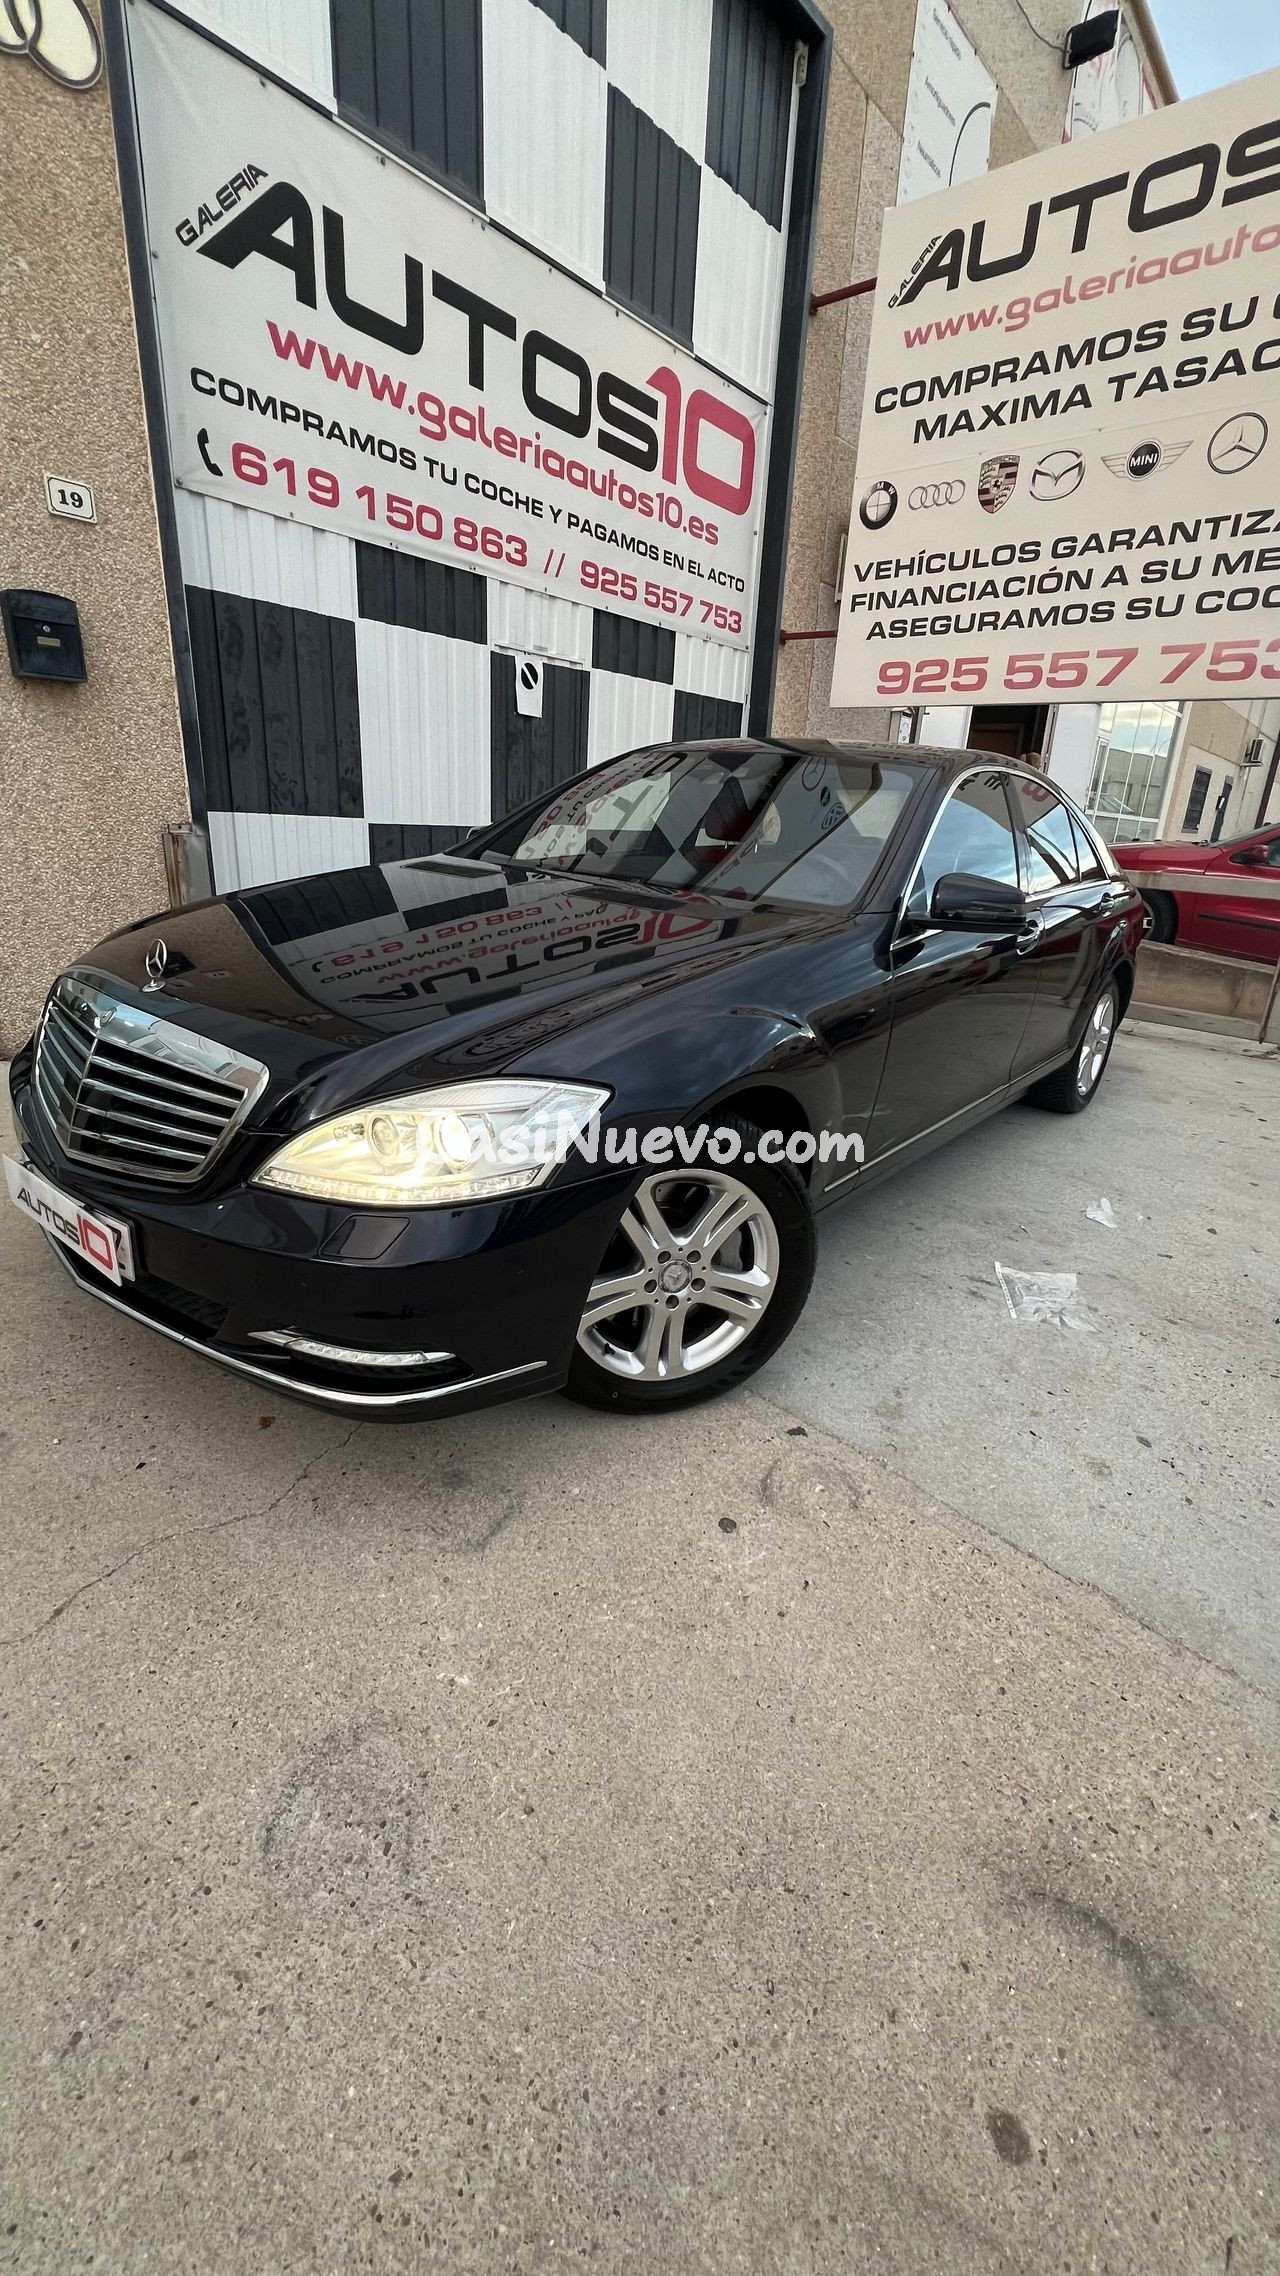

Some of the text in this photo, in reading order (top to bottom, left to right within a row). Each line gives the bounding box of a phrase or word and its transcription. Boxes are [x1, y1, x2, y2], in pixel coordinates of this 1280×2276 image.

[175, 163, 268, 247] GALERIA
[887, 234, 942, 309] GALERIA
[874, 295, 1259, 414] COMPRAMOS SU
[266, 319, 719, 545] www.galeriaautos10.es
[912, 383, 1093, 444] MAXIMA
[190, 367, 745, 593] COMPRAMOS TU COCHE Y PAGAMOS EN EL ACTO
[1129, 452, 1158, 468] MINI
[58, 489, 84, 509] 19
[231, 442, 340, 509] 619
[355, 485, 443, 541] 150
[453, 516, 528, 568] 863
[580, 559, 638, 602] 925
[643, 581, 693, 617] 557
[699, 600, 742, 634] 753
[853, 508, 1280, 583] VEHÍCULOS GARANTIZ
[850, 565, 1094, 613] FINANCIACIÓN
[1100, 564, 1130, 589] A
[1140, 555, 1202, 584] SU
[866, 600, 1116, 641] ASEGURAMOS
[1125, 593, 1186, 621] SU
[876, 655, 989, 695] 925
[1003, 647, 1139, 690] 557
[17, 1187, 114, 1271] AUTOS10
